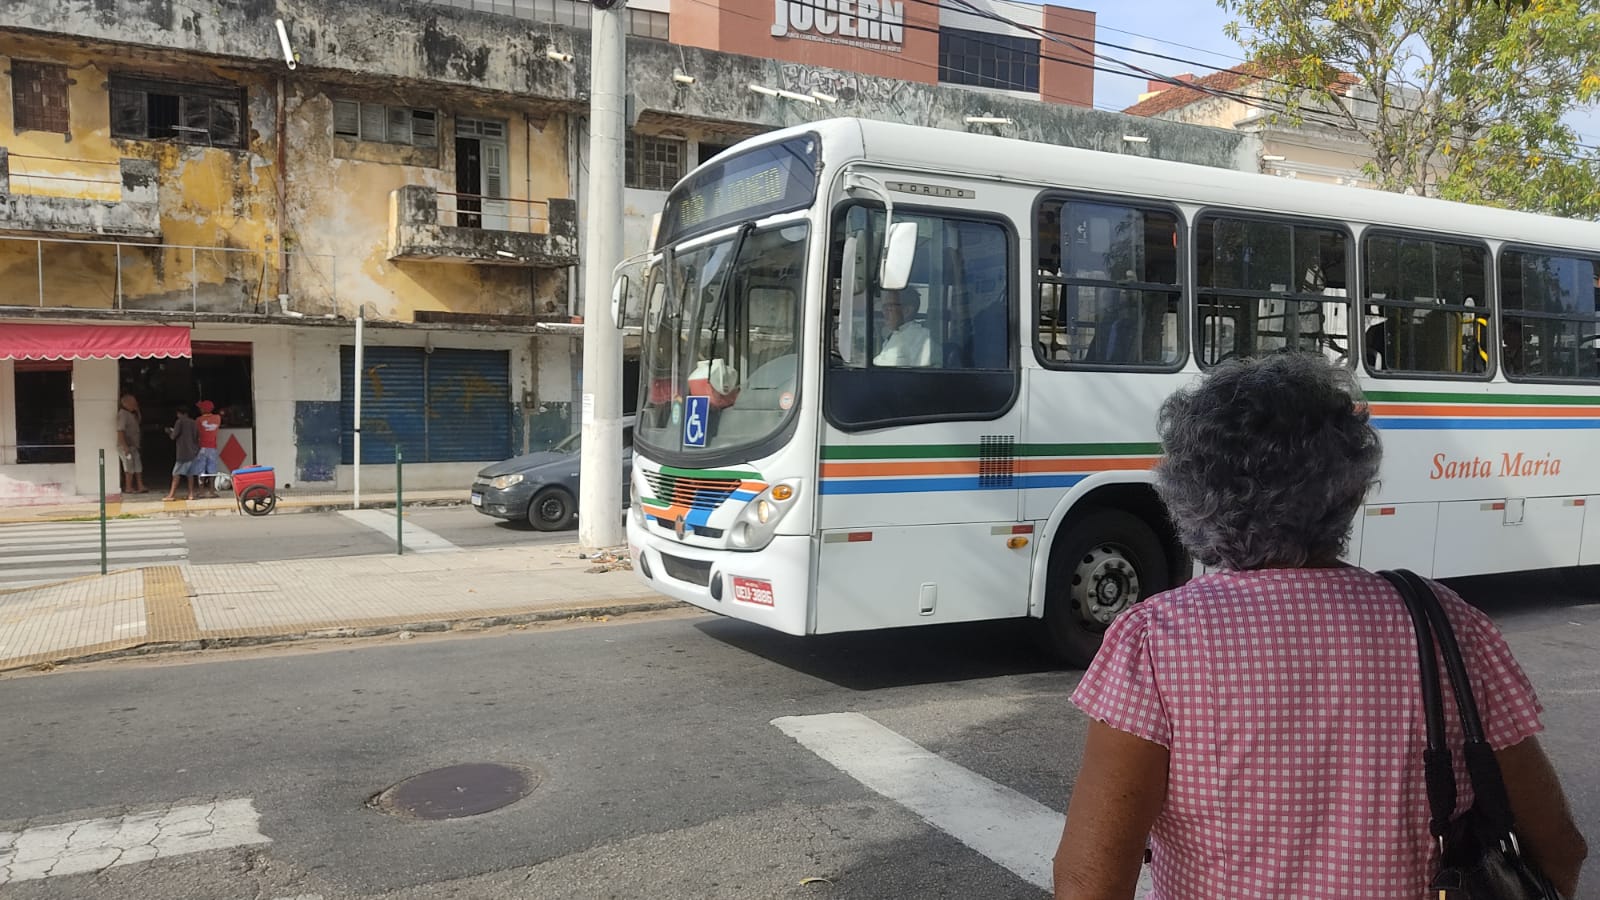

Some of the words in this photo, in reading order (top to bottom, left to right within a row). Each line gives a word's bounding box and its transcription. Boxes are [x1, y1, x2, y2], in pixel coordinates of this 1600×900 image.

[771, 0, 903, 43] JUCERN
[897, 183, 964, 198] TORINO
[1429, 452, 1492, 480] Santa
[1497, 451, 1562, 478] Maria
